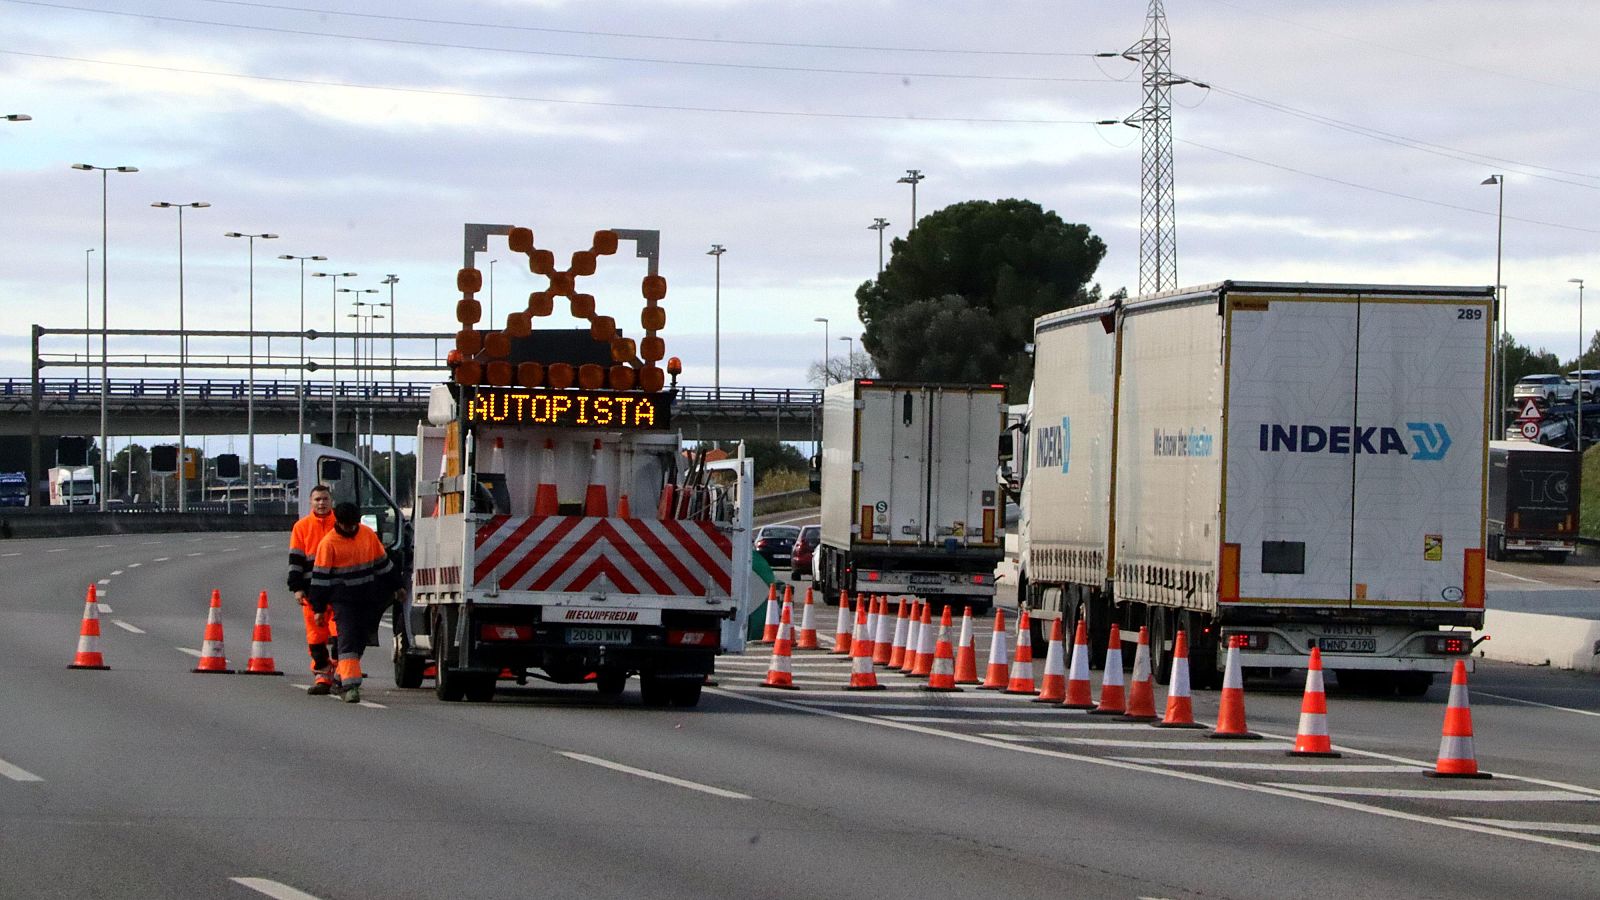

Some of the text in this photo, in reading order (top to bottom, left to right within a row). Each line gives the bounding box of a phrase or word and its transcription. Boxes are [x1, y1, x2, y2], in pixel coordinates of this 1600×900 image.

[1457, 308, 1482, 320] 289
[468, 393, 655, 426] AUTOPISTA
[1259, 423, 1408, 455] INDEKA
[1036, 425, 1063, 468] INDEKA
[576, 610, 627, 620] EQUIPFRED
[572, 630, 602, 641] 2060
[1326, 640, 1348, 650] WND
